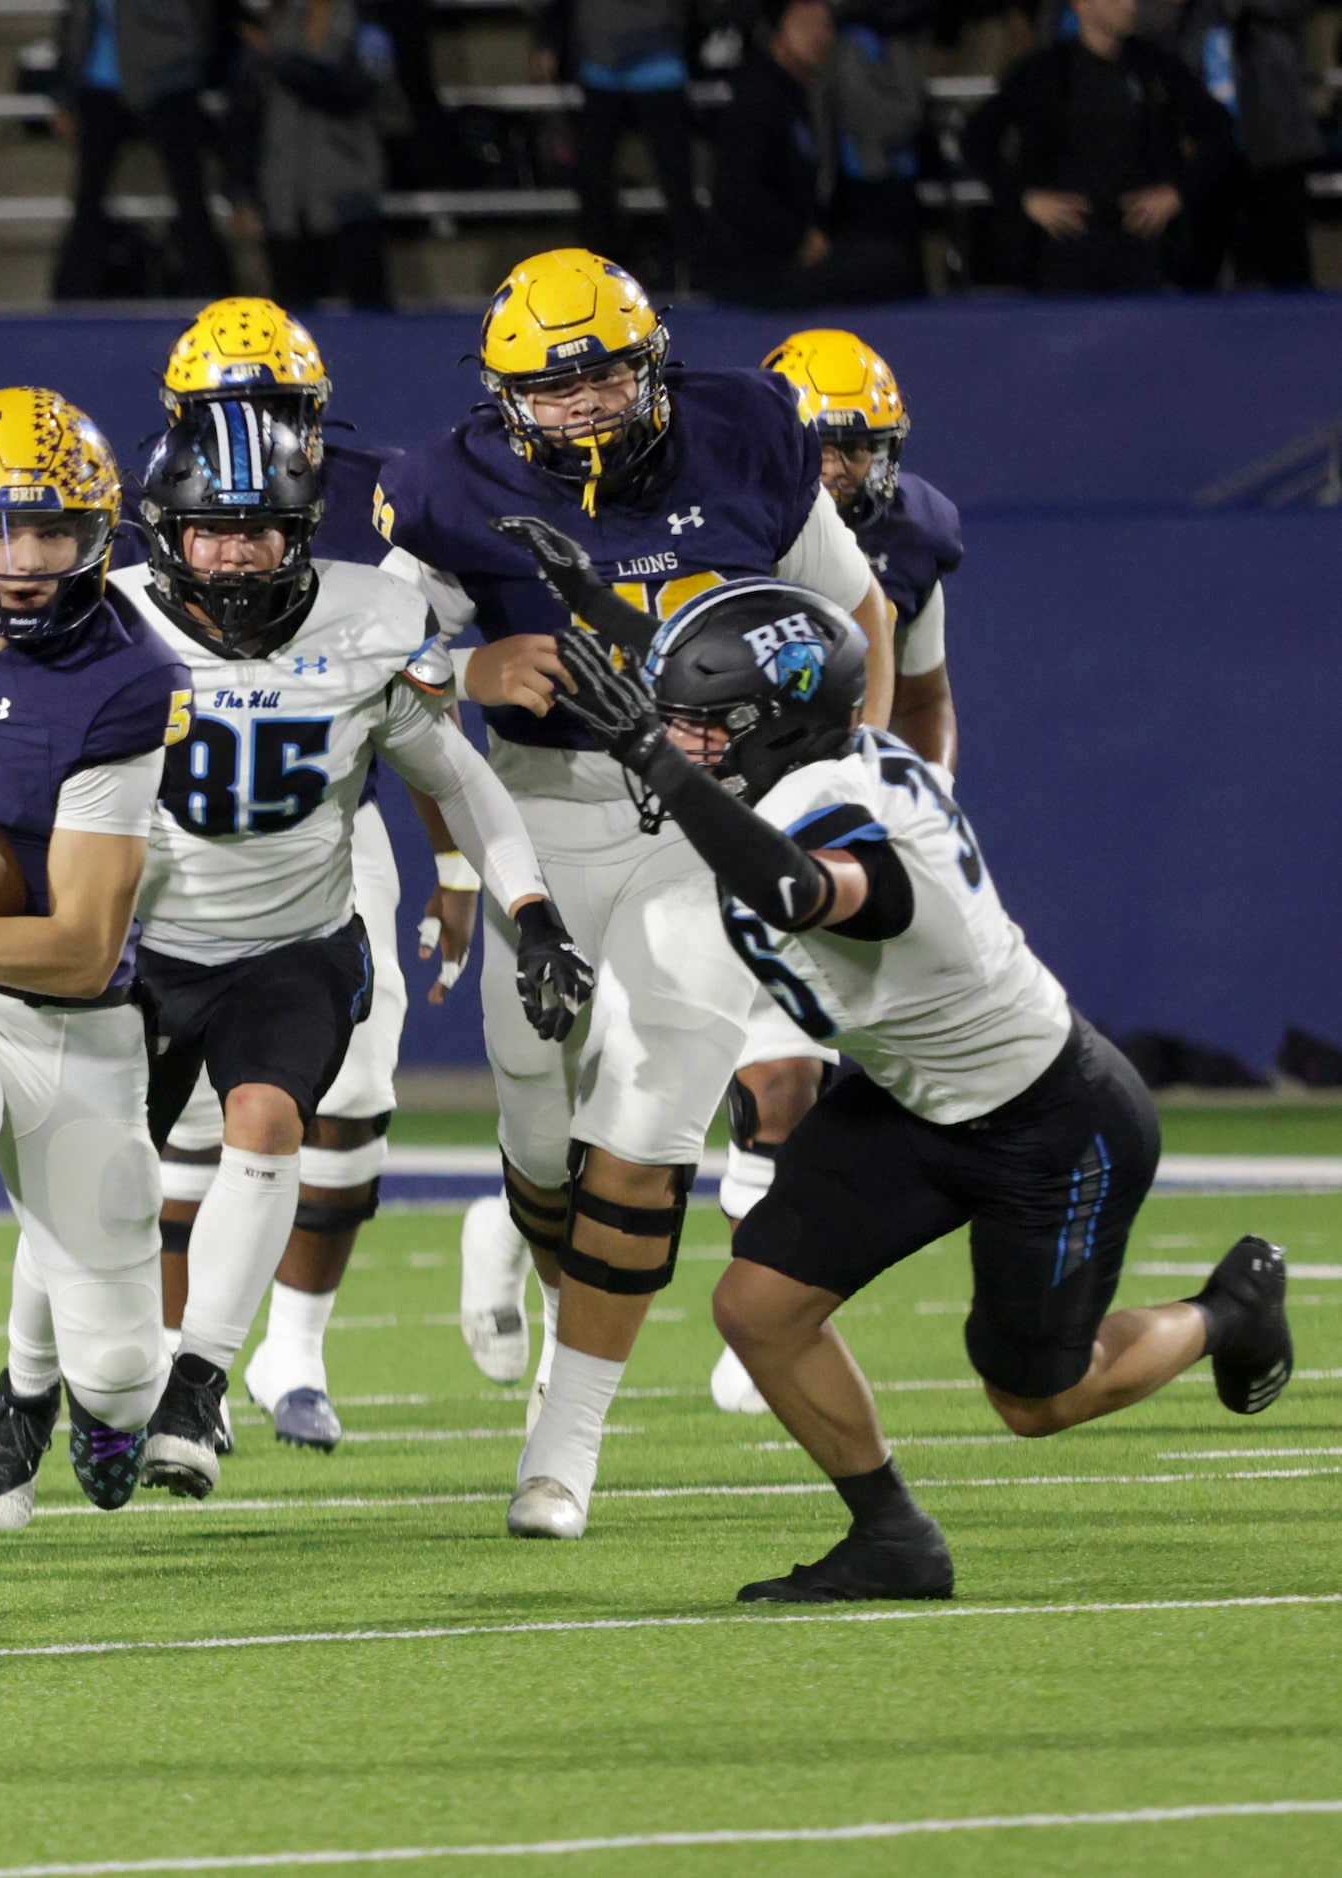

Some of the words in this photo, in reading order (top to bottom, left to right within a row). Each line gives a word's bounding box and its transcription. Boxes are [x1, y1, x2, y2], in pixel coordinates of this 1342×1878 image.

[9, 486, 46, 503] GRIT
[617, 551, 679, 577] LIONS
[213, 689, 243, 709] The
[248, 689, 281, 709] Hill
[164, 689, 192, 747] 5
[158, 713, 334, 836] 85
